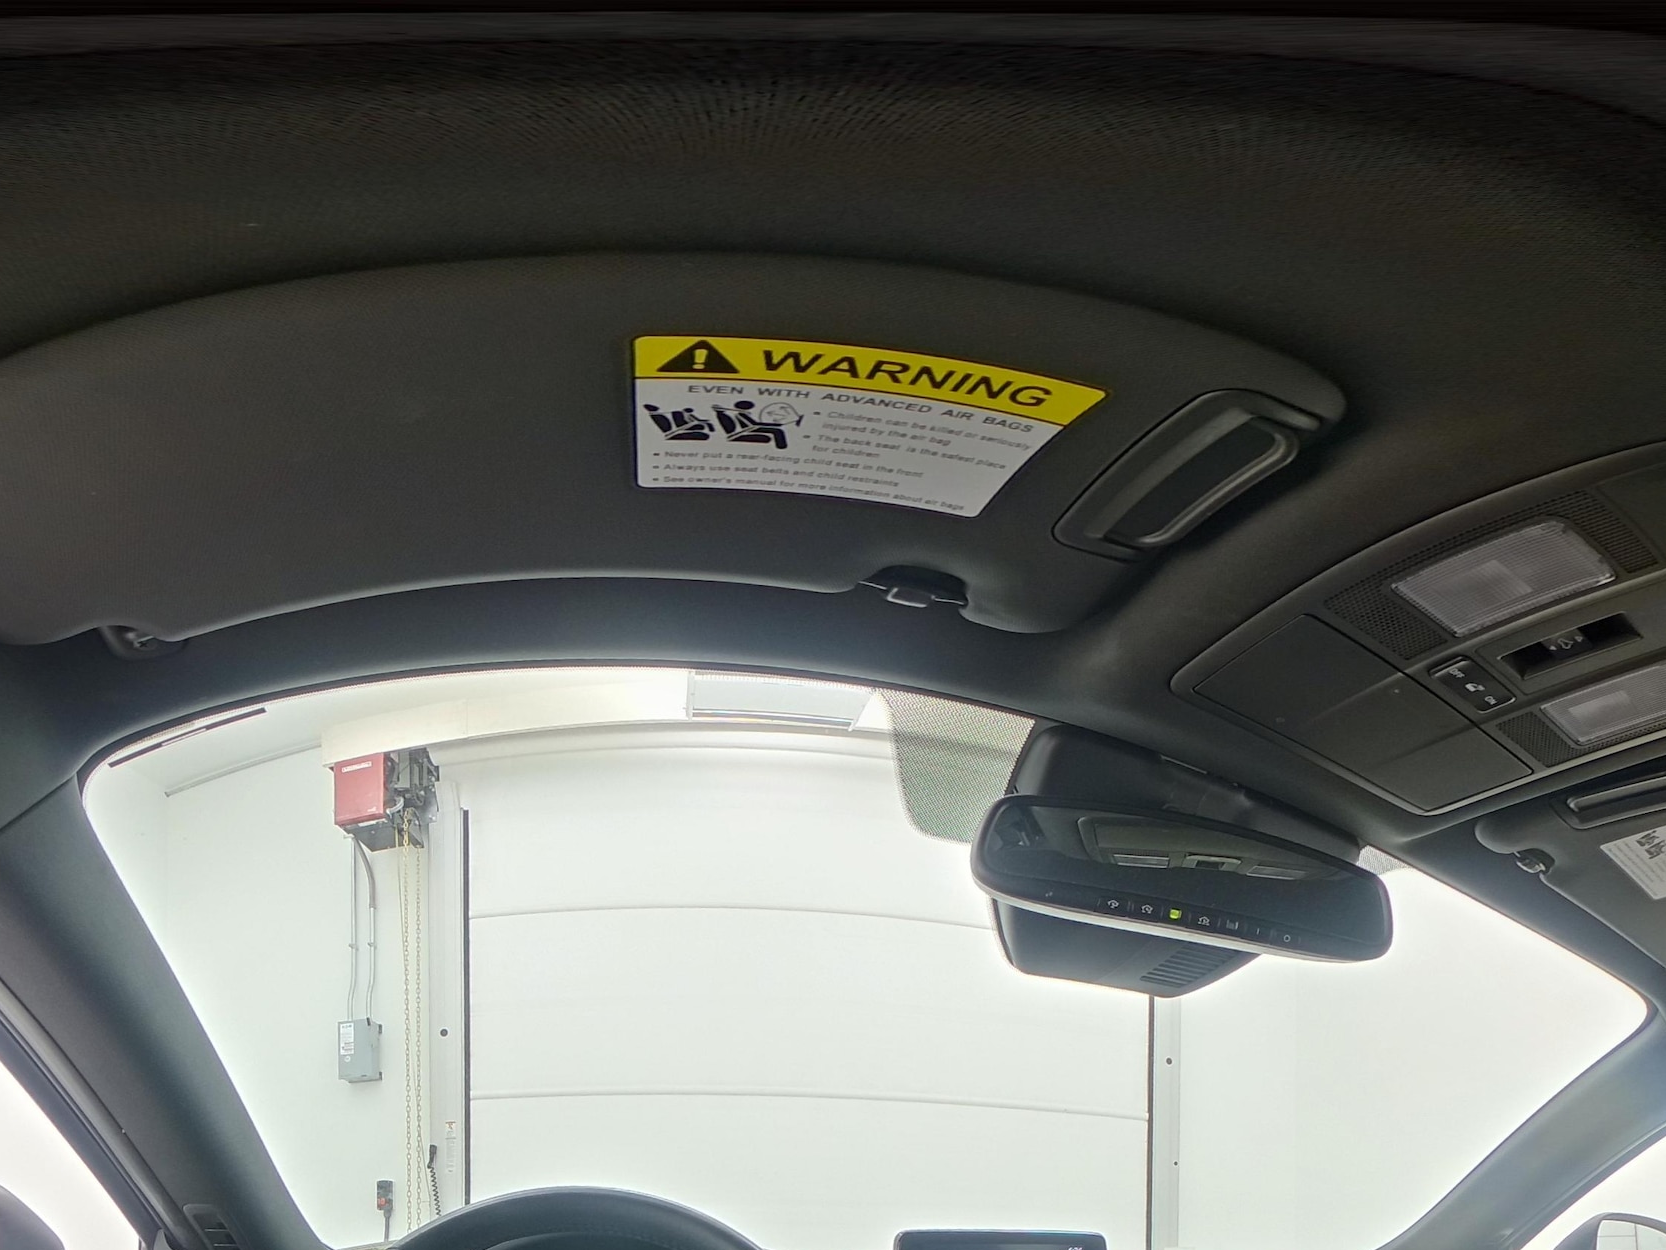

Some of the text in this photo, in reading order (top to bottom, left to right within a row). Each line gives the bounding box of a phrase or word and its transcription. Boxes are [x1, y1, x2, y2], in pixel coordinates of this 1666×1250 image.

[763, 349, 1053, 407] WARNING
[687, 385, 1034, 434] EVEN WITH ADVANCED AIR BAGS
[821, 421, 952, 448] injured by the air bag
[827, 410, 1031, 452] Children can be killed or seriously
[664, 451, 699, 459] Never
[702, 451, 722, 461] put
[737, 452, 801, 465] rear-facing
[803, 456, 833, 467] child
[835, 460, 860, 469] seat
[862, 462, 874, 471] in
[876, 464, 895, 474] the
[896, 467, 924, 478] front
[811, 444, 880, 459] for children
[817, 433, 1007, 470] The back seat is the safest place
[663, 463, 899, 488] Always use seat belts and child restraints
[663, 476, 964, 512] See owner's manual for more information about air bags
